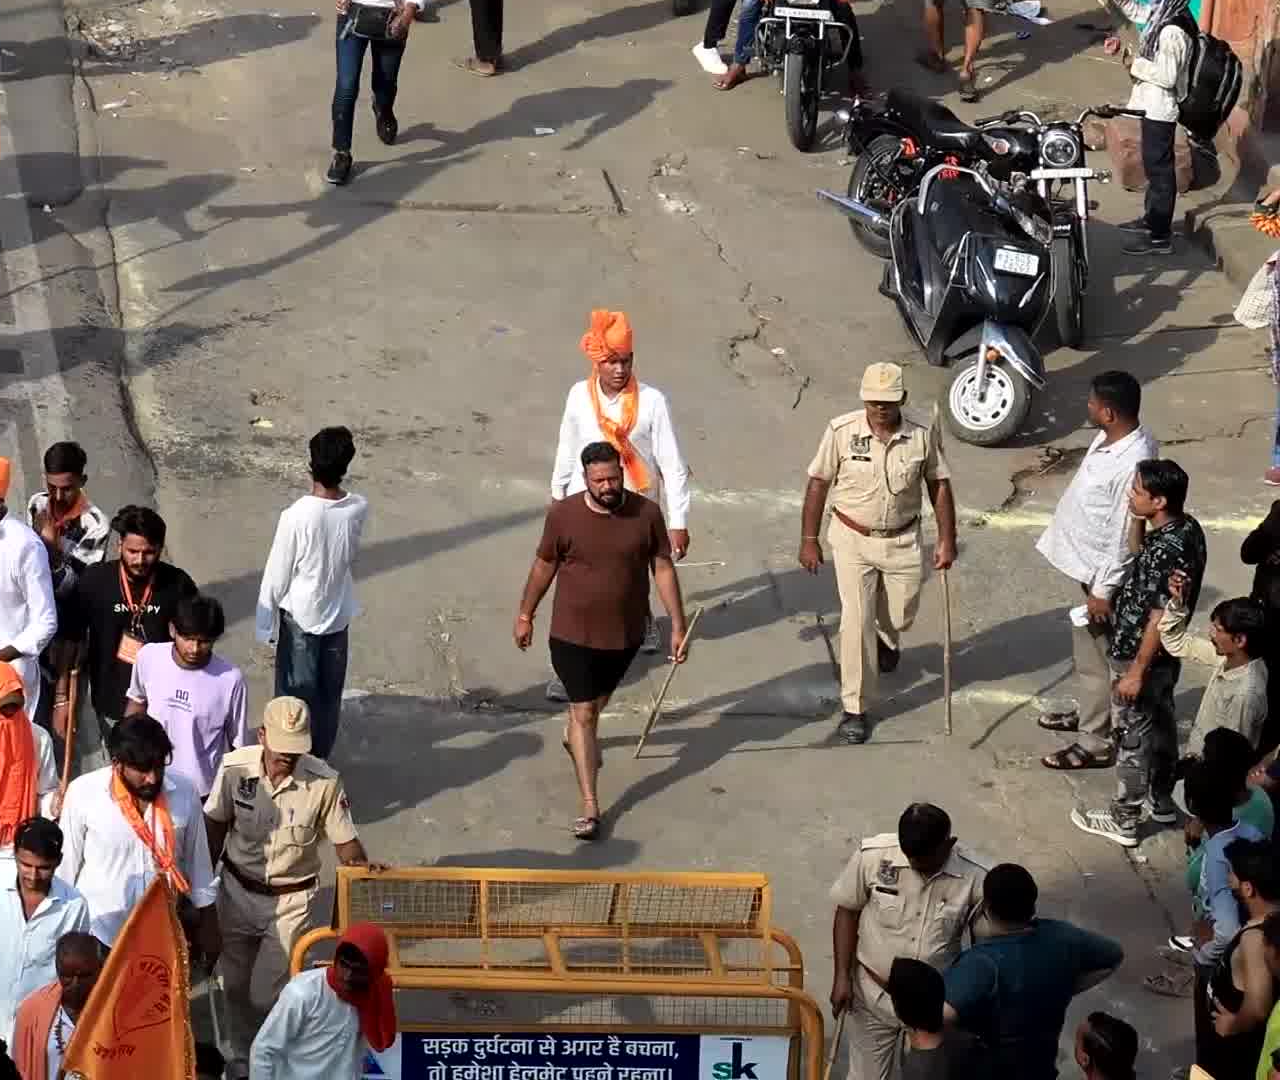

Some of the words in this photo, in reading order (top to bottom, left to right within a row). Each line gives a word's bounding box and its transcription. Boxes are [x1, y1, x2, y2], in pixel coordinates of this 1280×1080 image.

[422, 1038, 470, 1058] सड़क
[472, 1034, 534, 1060] दुर्घटना
[538, 1034, 557, 1056] से
[561, 1040, 604, 1056] अगर
[607, 1035, 622, 1056] है
[624, 1040, 679, 1060] बचना,
[426, 1060, 448, 1080] तो
[450, 1060, 505, 1080] हमेशा
[508, 1060, 568, 1080] हेलमेट
[570, 1062, 614, 1080] पहने
